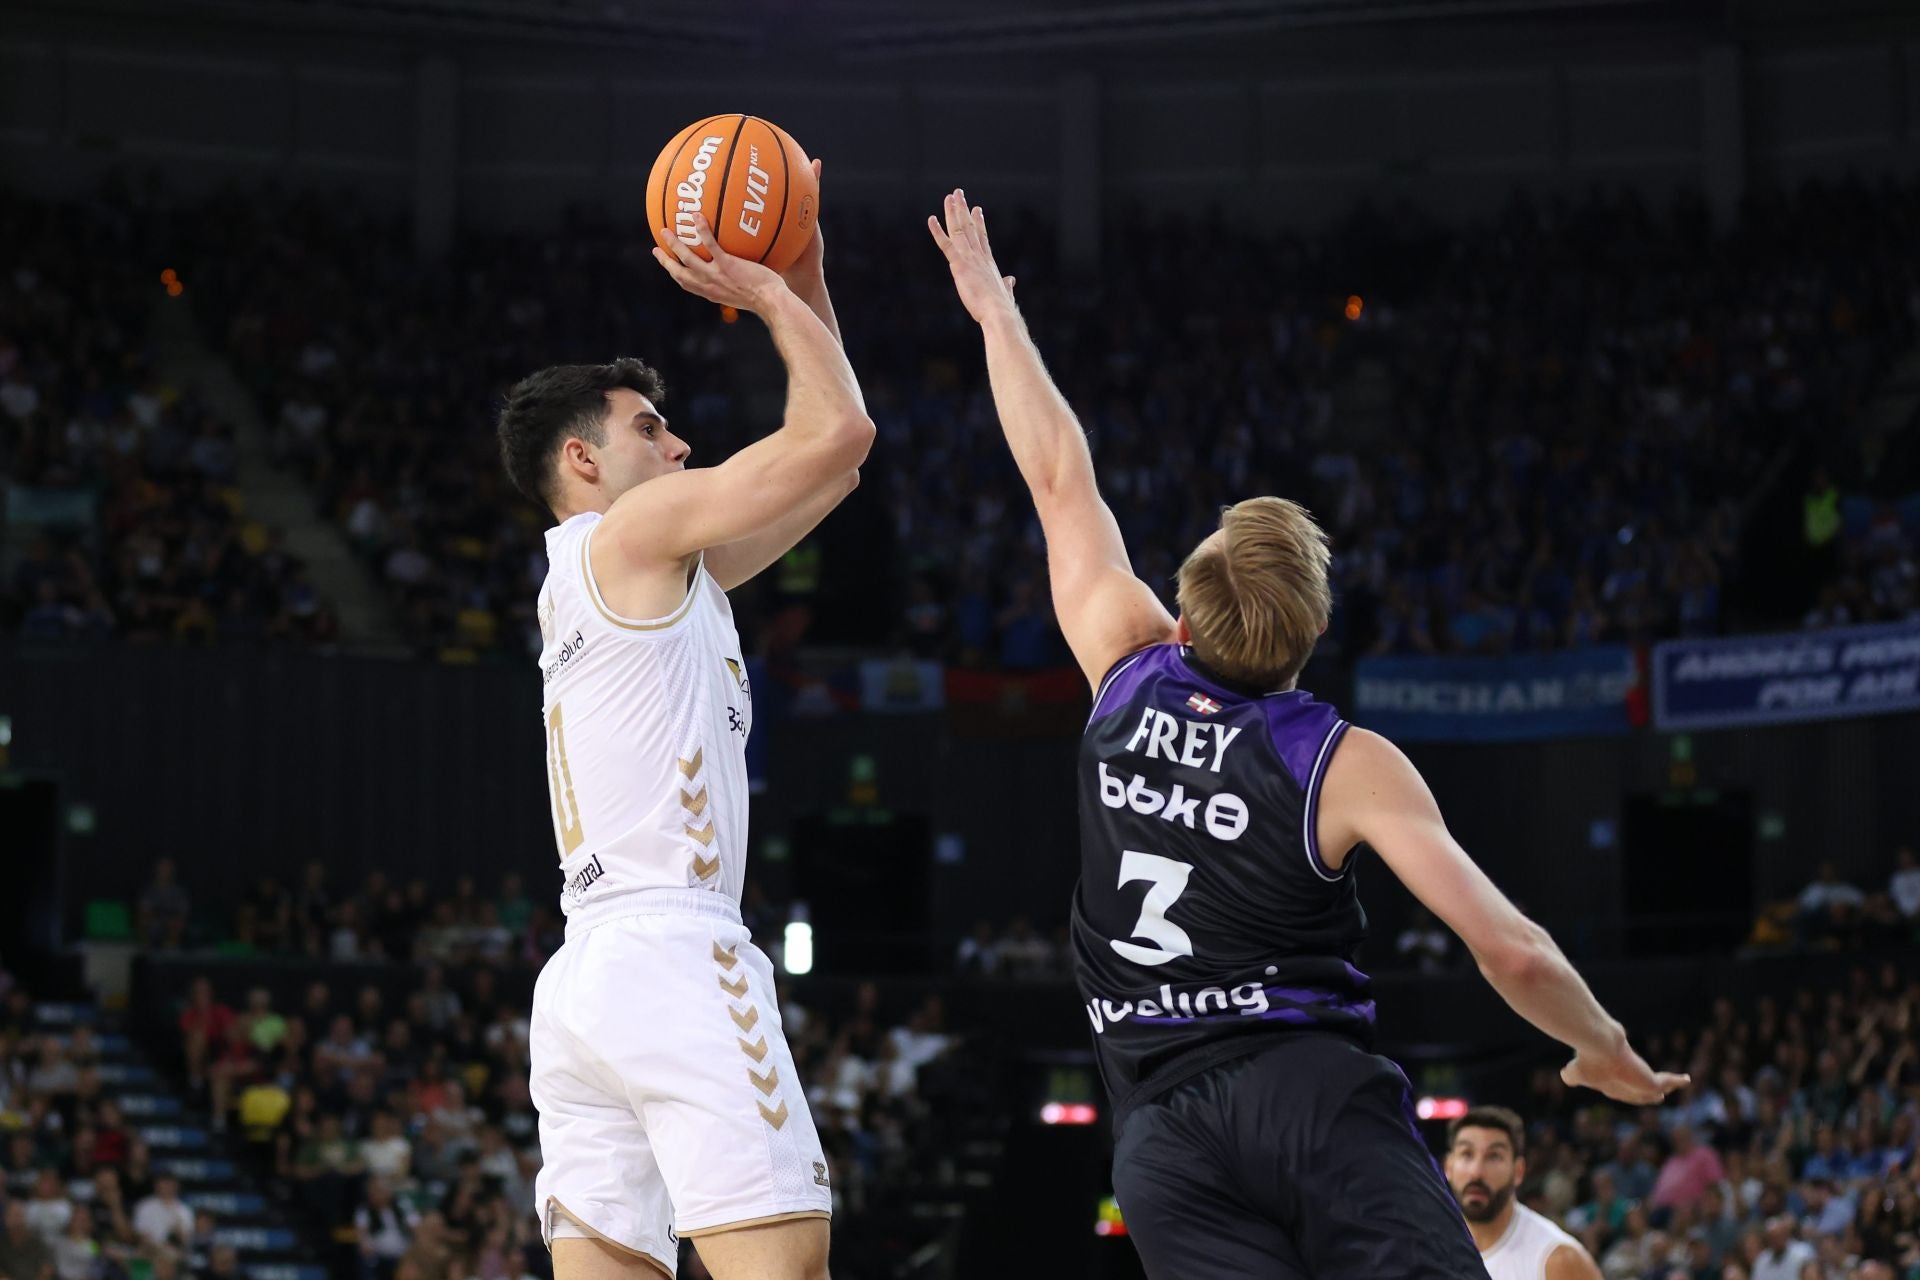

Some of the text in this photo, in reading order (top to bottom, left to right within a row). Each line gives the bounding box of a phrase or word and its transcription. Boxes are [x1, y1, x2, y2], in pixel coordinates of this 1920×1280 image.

[675, 136, 725, 247] Wilson
[738, 143, 770, 237] EVO NXT
[1125, 706, 1242, 773] FREY
[1109, 849, 1195, 966] 3
[1086, 981, 1270, 1034] vueling
